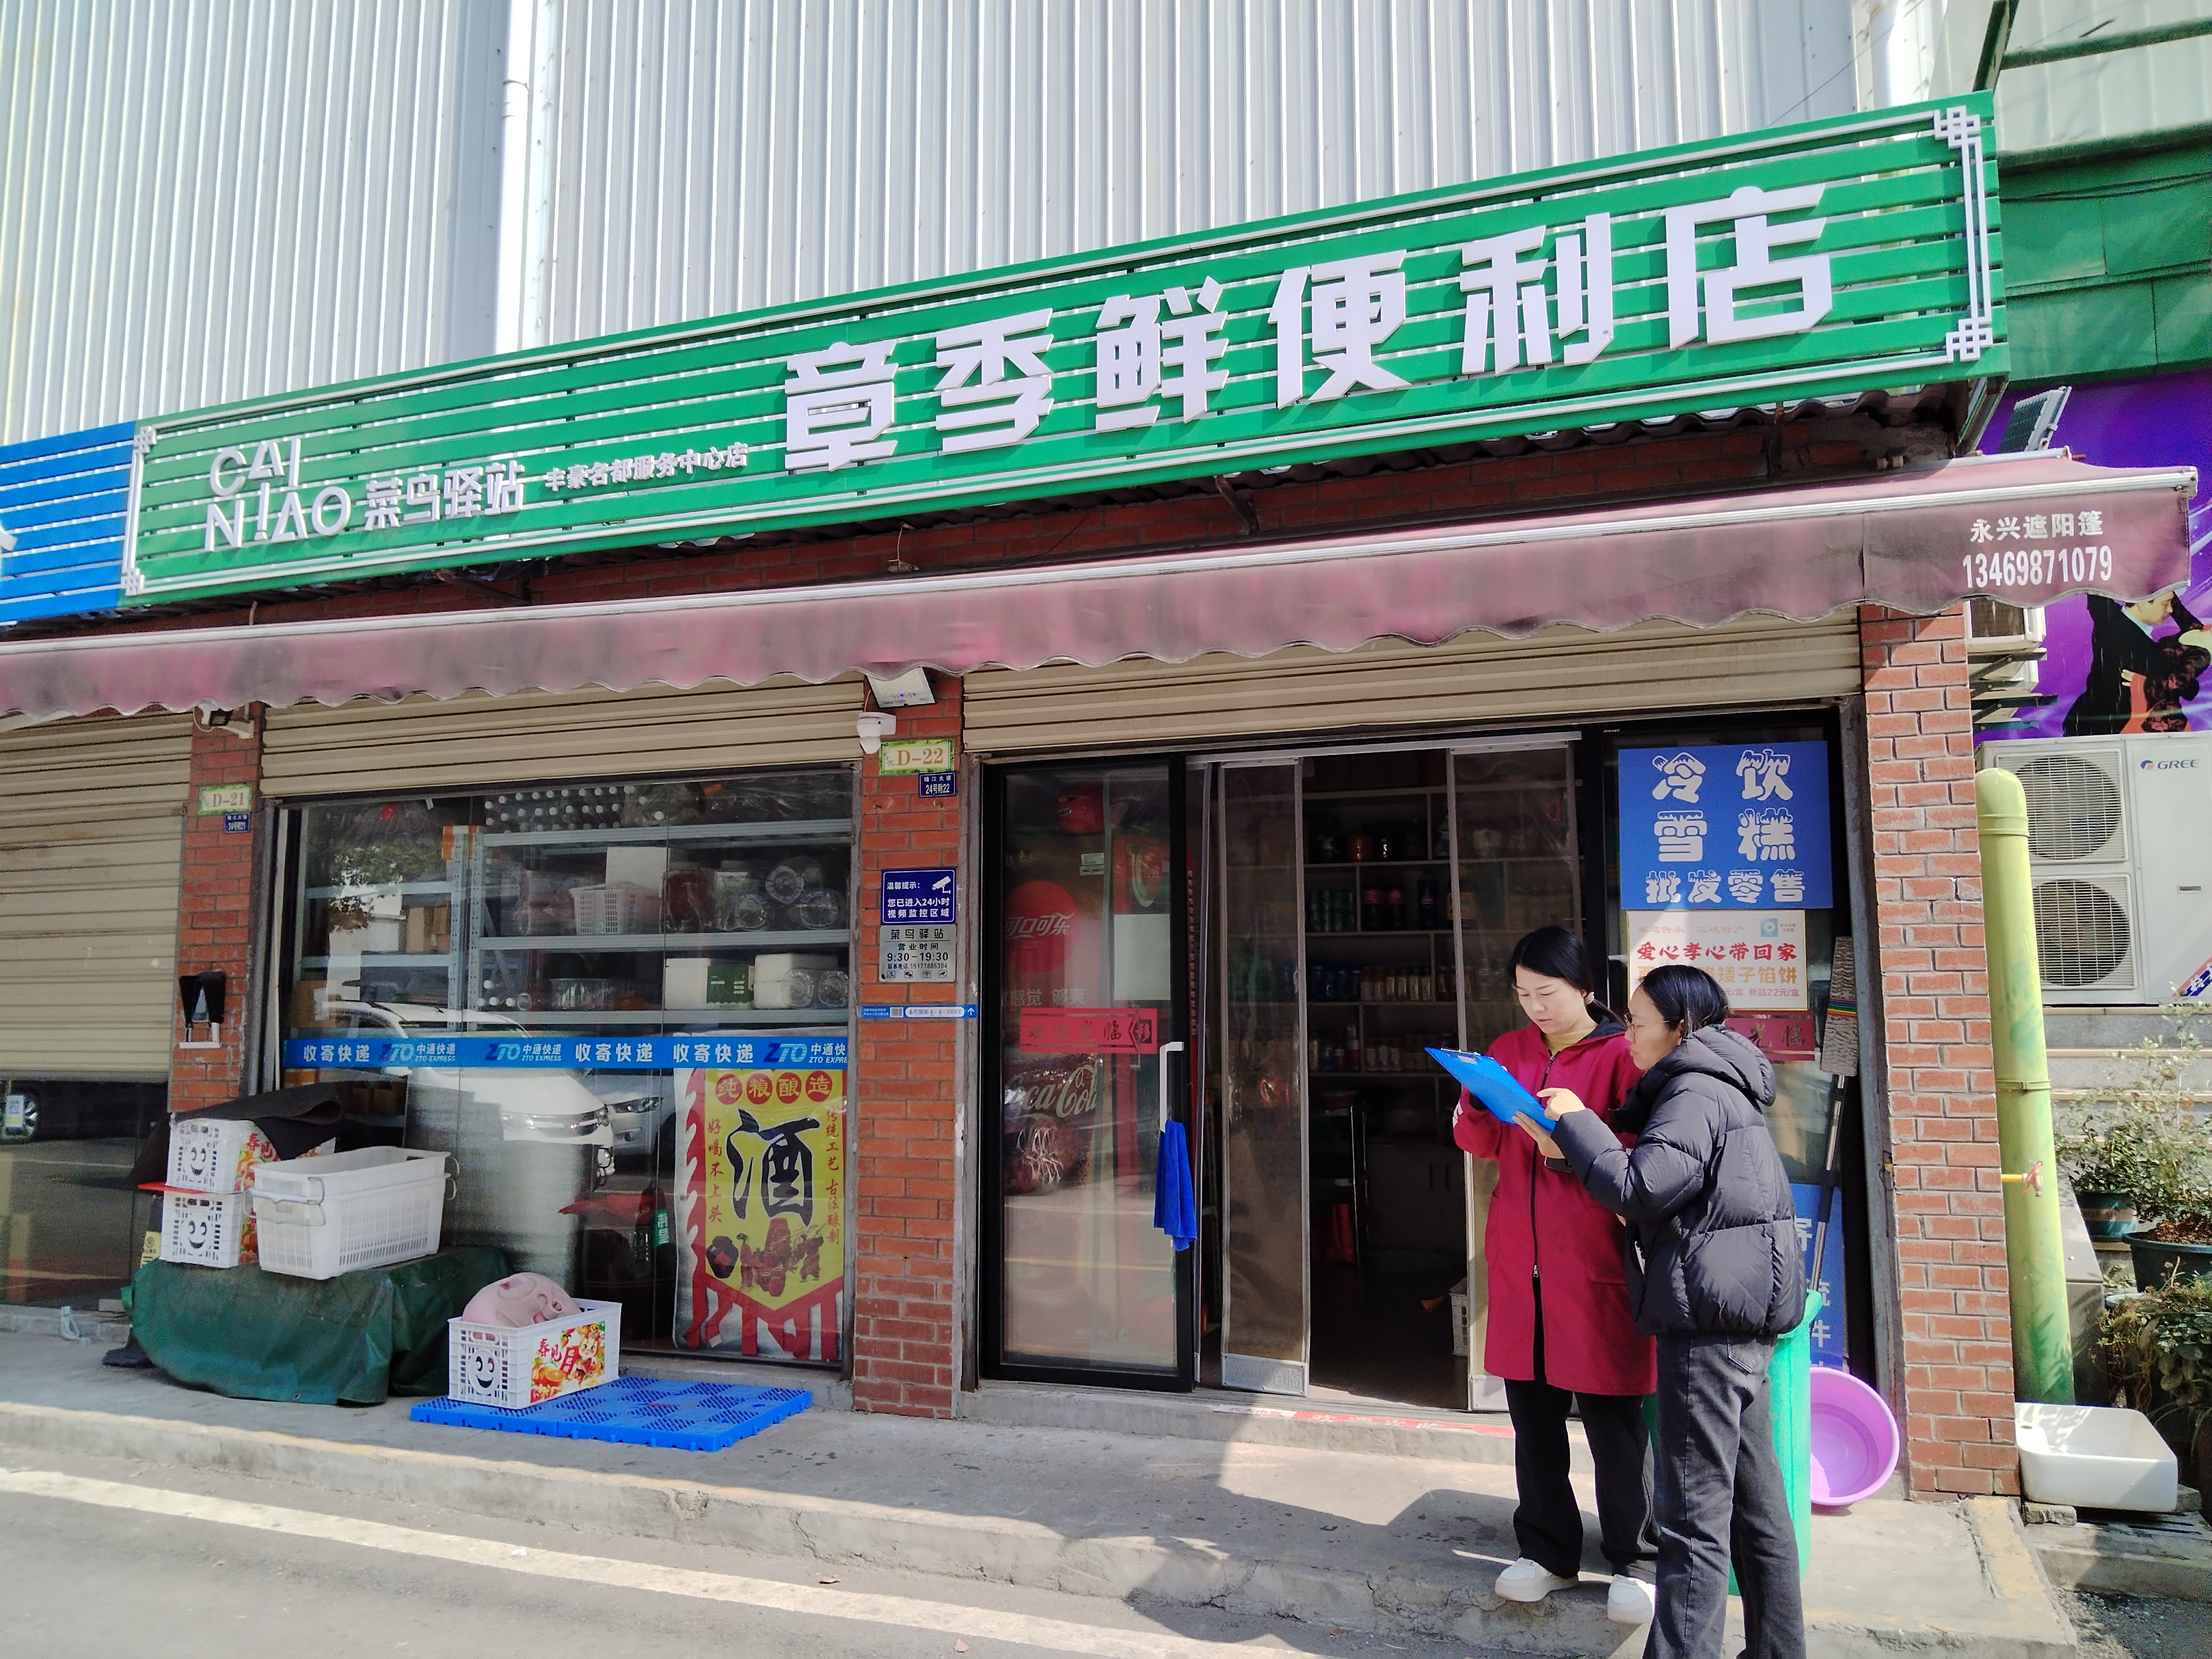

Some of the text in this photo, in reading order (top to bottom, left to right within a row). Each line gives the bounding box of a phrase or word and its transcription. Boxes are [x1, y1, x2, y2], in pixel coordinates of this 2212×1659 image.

[784, 184, 1834, 471] 章季鲜便利店
[209, 437, 301, 497] CAI
[545, 441, 748, 492] 丰豪名都服务中心店
[364, 460, 525, 531] 菜鸟驿站
[204, 482, 352, 552] NIAO
[1970, 510, 2104, 544] 永兴遮阳篷
[1963, 545, 2113, 589] 13469871079
[896, 747, 943, 766] D-22
[2157, 759, 2200, 769] GREE
[1652, 748, 1793, 803] 冷饮
[212, 792, 245, 807] D-21
[1654, 808, 1795, 861] 雪糕
[1645, 868, 1805, 904] 批发零售
[887, 897, 950, 907] 您已进入24小时
[887, 908, 950, 918] 视频监控区域
[891, 929, 943, 940] 菜鸟驿站
[1637, 926, 1745, 934] 非遗传承 三峡特产
[1637, 941, 1797, 961] 爱心孝心带回家
[1005, 989, 1042, 1006] 感觉
[1749, 988, 1800, 997] 新品22元/盒
[1028, 1020, 1122, 1042] 欢迎光临
[304, 1044, 370, 1063] 收寄快递
[381, 1043, 414, 1061] ZTO
[416, 1042, 456, 1055] 中通快递
[485, 1043, 521, 1061] ZTO
[522, 1043, 562, 1055] 中通快递
[575, 1043, 652, 1062] 收寄快递
[673, 1043, 753, 1063] 收寄快递
[763, 1043, 807, 1062] ZTO
[717, 1072, 832, 1100] 纯粮酿造
[707, 1118, 723, 1223] 好喝不上头
[726, 1108, 820, 1227] 酒
[825, 1108, 841, 1244] 传统工艺 古法酿制
[538, 1338, 562, 1363] 春见
